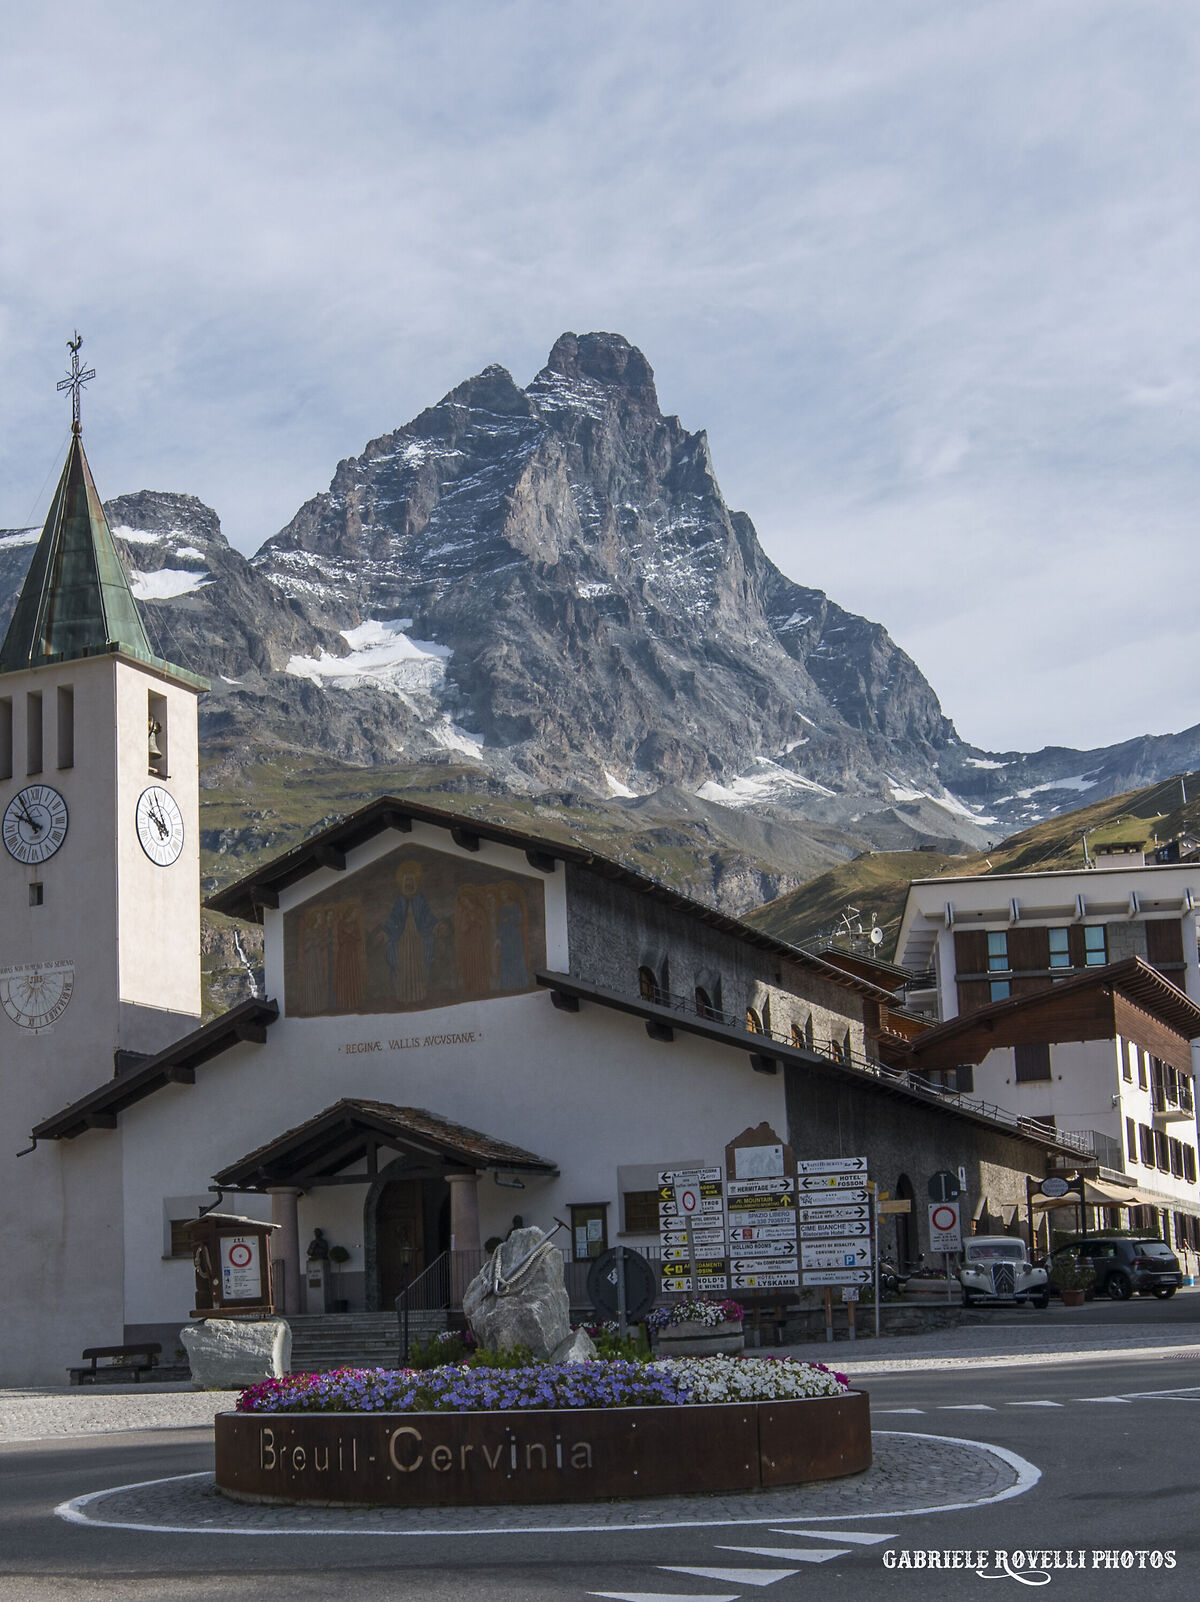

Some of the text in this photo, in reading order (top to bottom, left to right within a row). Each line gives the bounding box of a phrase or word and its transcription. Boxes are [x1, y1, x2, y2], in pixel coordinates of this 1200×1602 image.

[389, 1038, 420, 1049] VALLIS
[737, 1185, 769, 1193] HERMITAGE
[818, 1223, 847, 1231] BIANCHE
[757, 1279, 796, 1287] LYSKAMM
[389, 1426, 592, 1471] Cervinia
